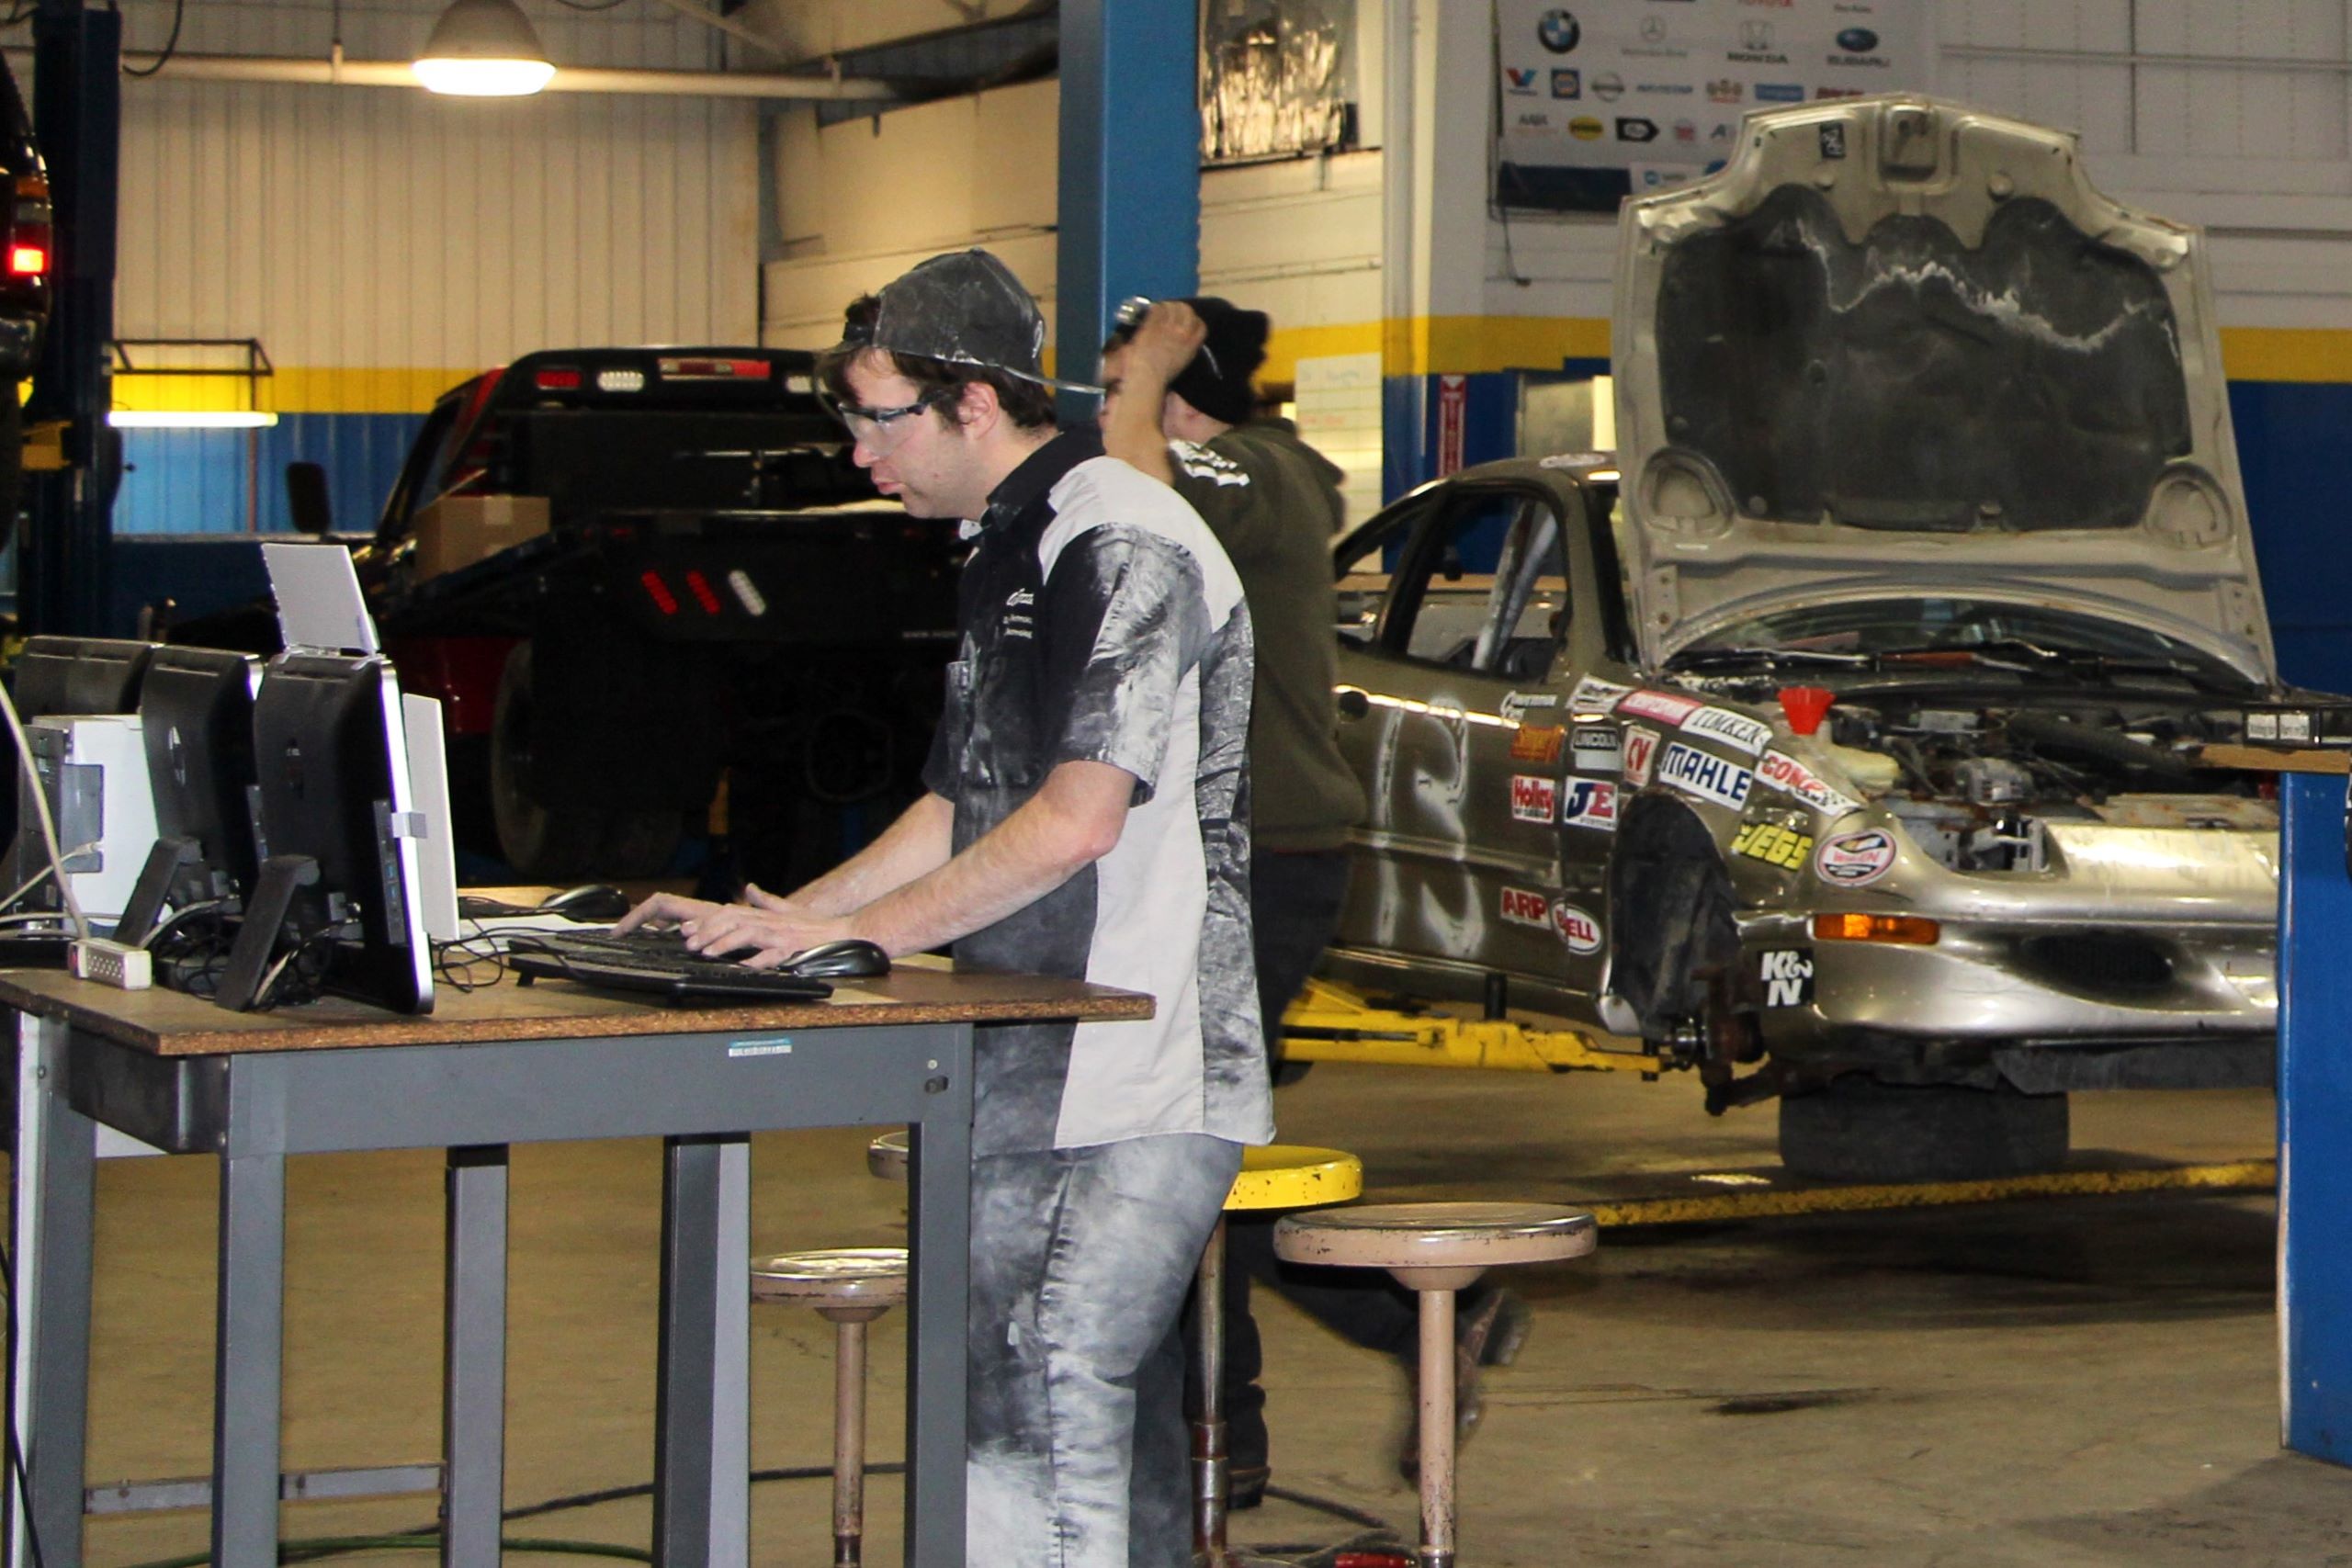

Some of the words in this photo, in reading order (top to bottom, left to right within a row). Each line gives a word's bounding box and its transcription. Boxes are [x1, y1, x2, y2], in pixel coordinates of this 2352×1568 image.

[1727, 51, 1789, 64] HONDA
[1692, 708, 1759, 746] TIMKEN
[1663, 744, 1752, 801] MAHLE
[1514, 776, 1554, 818] Holley
[1566, 781, 1614, 819] JE
[1733, 823, 1814, 871] JEGS
[1501, 887, 1548, 920] ARP
[1555, 908, 1596, 942] BELL
